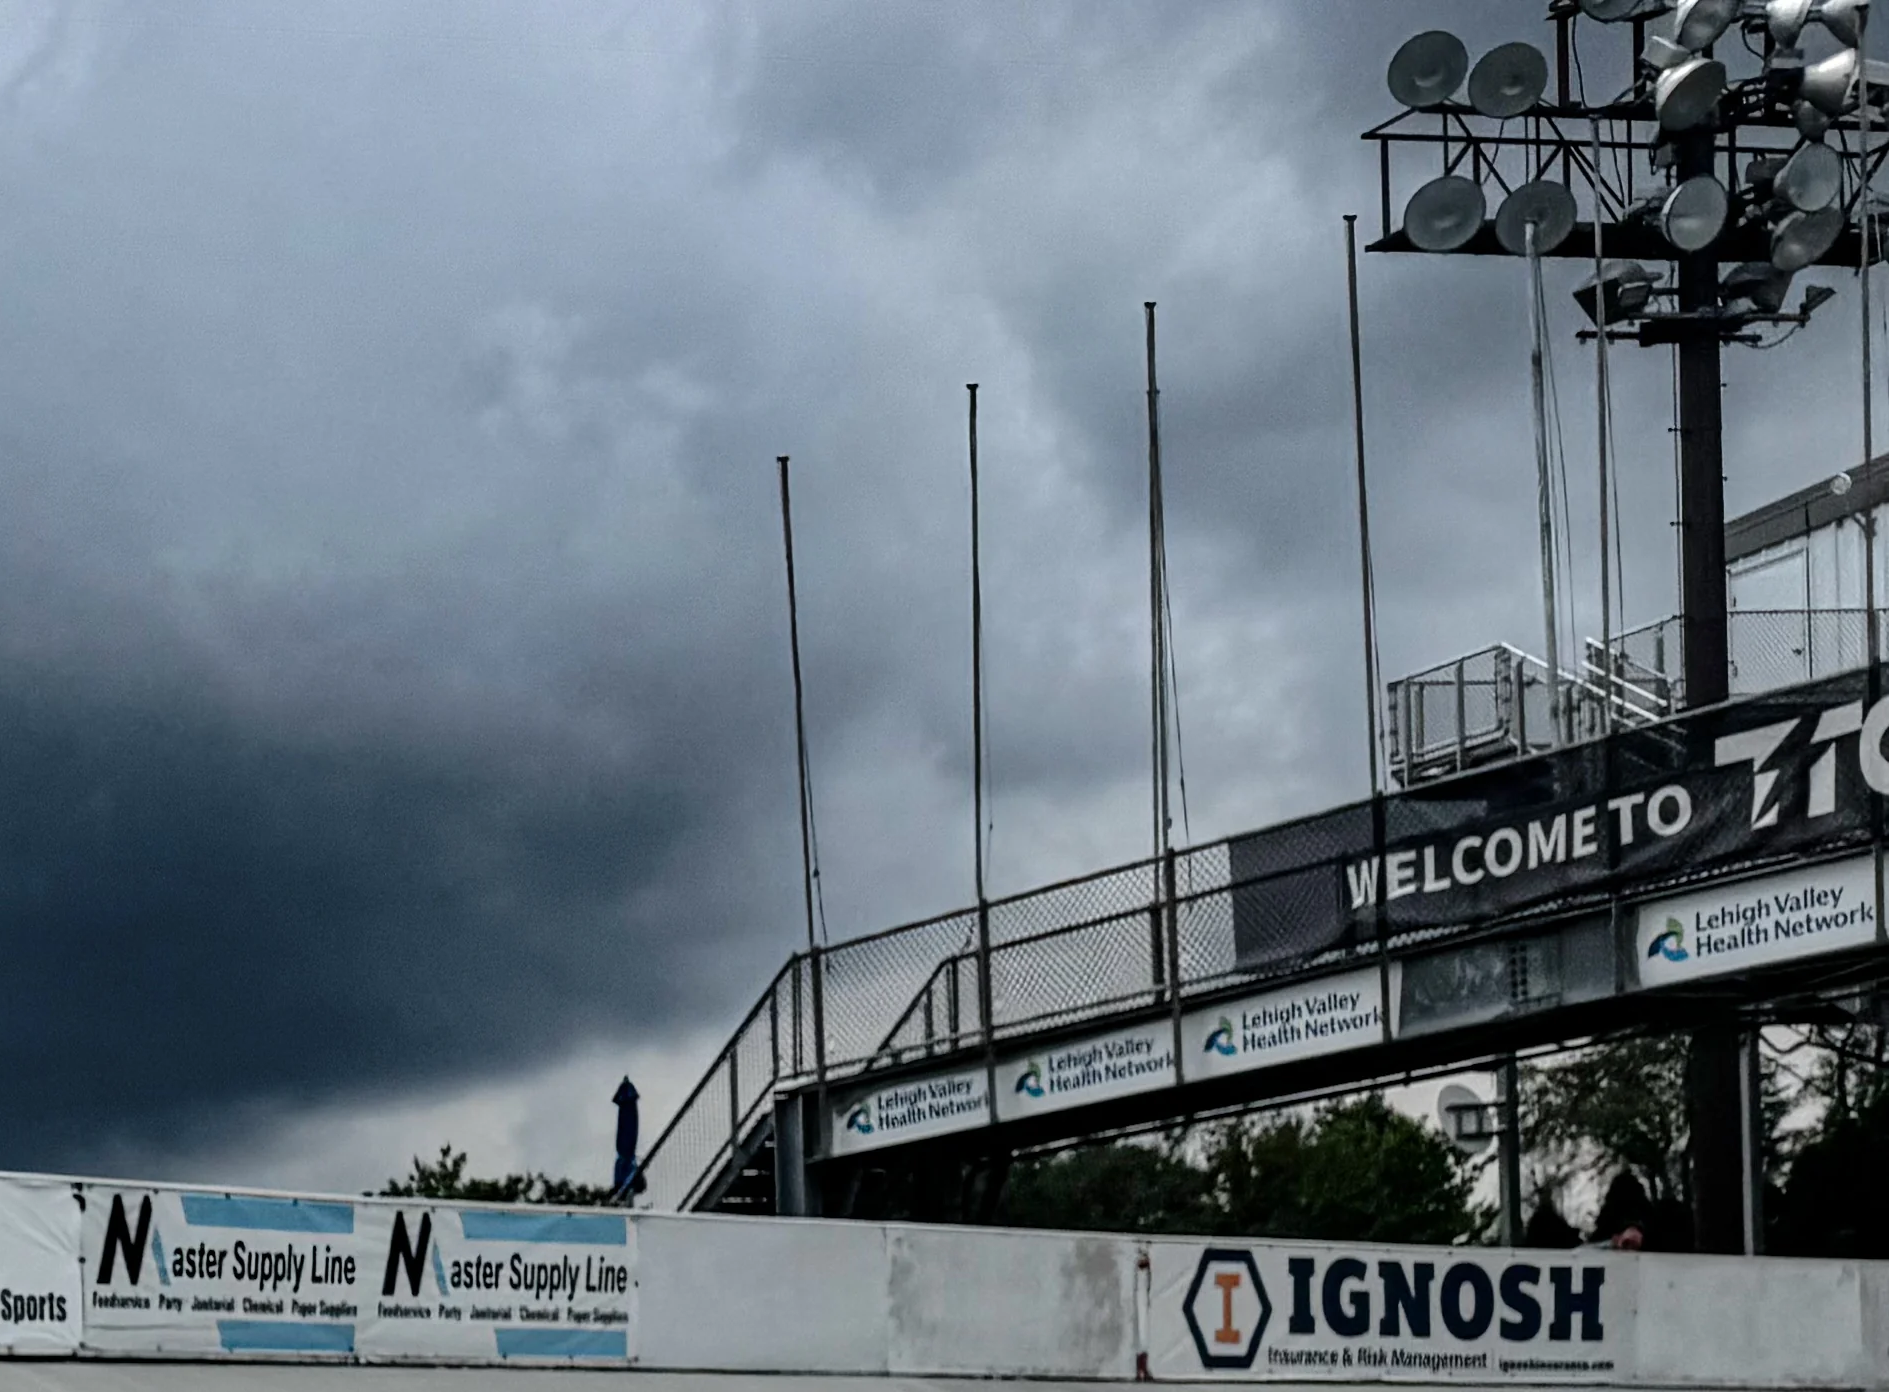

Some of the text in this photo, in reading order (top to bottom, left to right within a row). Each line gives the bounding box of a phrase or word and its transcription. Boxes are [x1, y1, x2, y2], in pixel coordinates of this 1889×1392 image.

[1347, 805, 1598, 910] WELCOME
[1608, 783, 1693, 846] TO
[1695, 886, 1844, 932] Lehigh Valley
[1696, 901, 1874, 957] Health Network
[1242, 991, 1360, 1031] Lehigh Valley
[1048, 1038, 1154, 1073] Lehigh Valley
[1243, 1022, 1302, 1053] Health
[877, 1078, 973, 1111] Lehigh Valley
[1050, 1064, 1103, 1093] Health
[232, 1240, 306, 1294] Supply
[311, 1244, 357, 1286] Line
[510, 1253, 580, 1301] Supply
[585, 1255, 628, 1293] Line
[0, 1288, 67, 1324] Sports
[1287, 1256, 1606, 1343] IGNOSH
[1268, 1345, 1339, 1367] Insurance
[1342, 1347, 1353, 1368] &
[1358, 1348, 1387, 1367] Risk
[1390, 1349, 1488, 1373] Management
